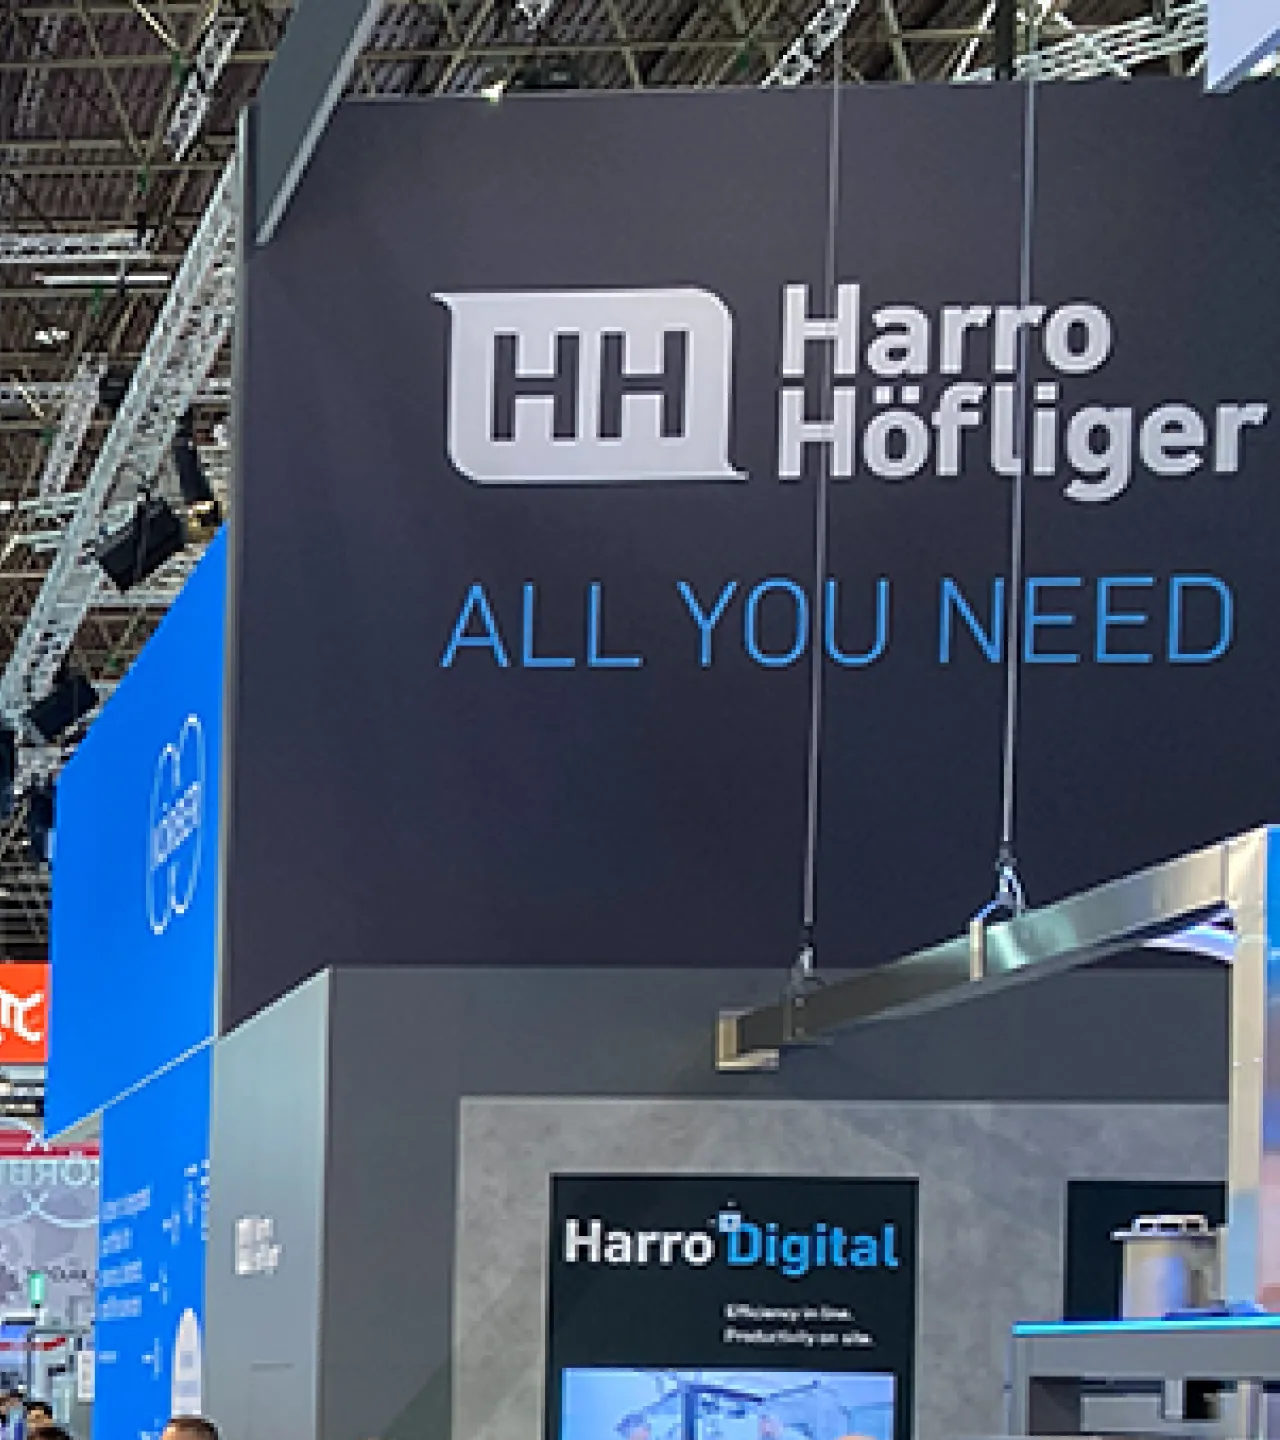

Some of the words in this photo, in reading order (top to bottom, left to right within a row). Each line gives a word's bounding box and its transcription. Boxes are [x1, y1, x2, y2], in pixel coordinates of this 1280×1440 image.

[781, 283, 1112, 378] Harro
[777, 383, 1268, 502] Höfliger
[441, 580, 644, 669] ALL
[677, 577, 890, 669] YOU
[939, 575, 1236, 667] NEED
